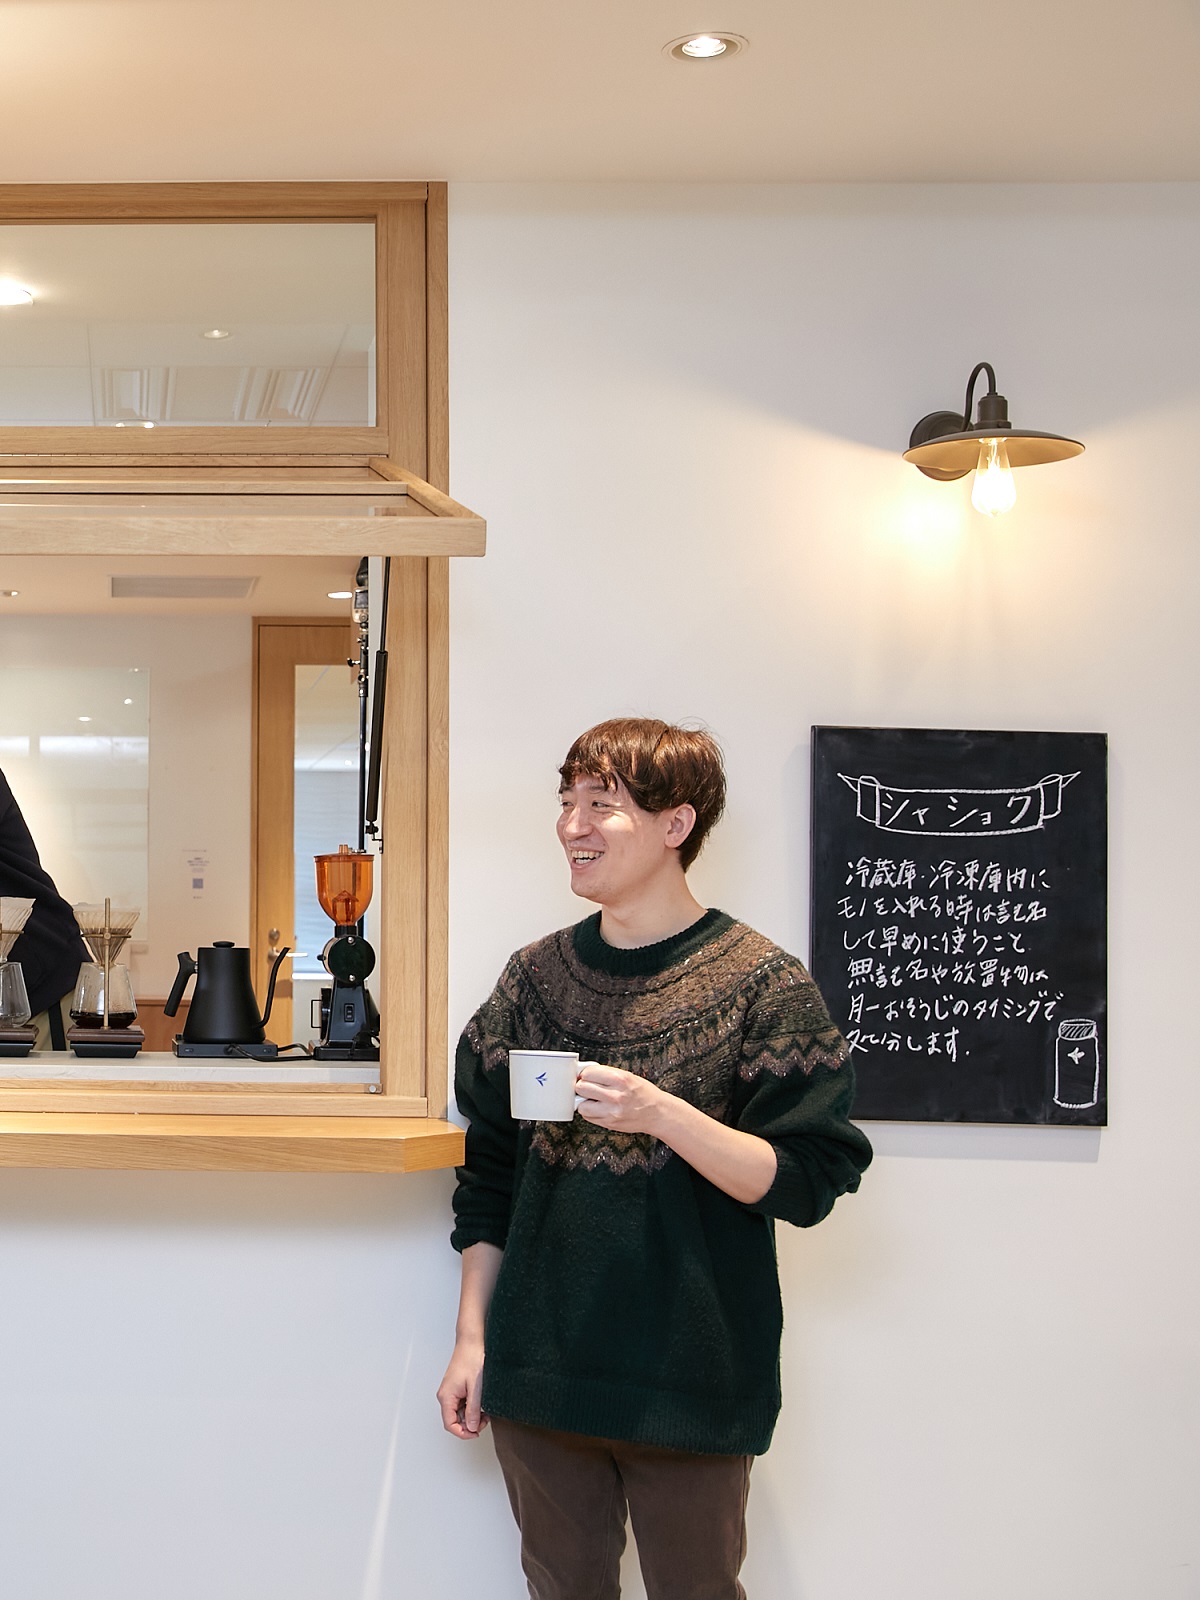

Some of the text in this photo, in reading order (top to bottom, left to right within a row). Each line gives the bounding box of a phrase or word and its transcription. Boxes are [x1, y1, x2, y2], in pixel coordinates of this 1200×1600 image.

[881, 792, 1032, 827] シャショク
[837, 894, 1047, 926] モノを入れる時は記名
[843, 925, 1027, 957] して早めに使うこと
[847, 957, 1049, 989] 無記名や放置物は
